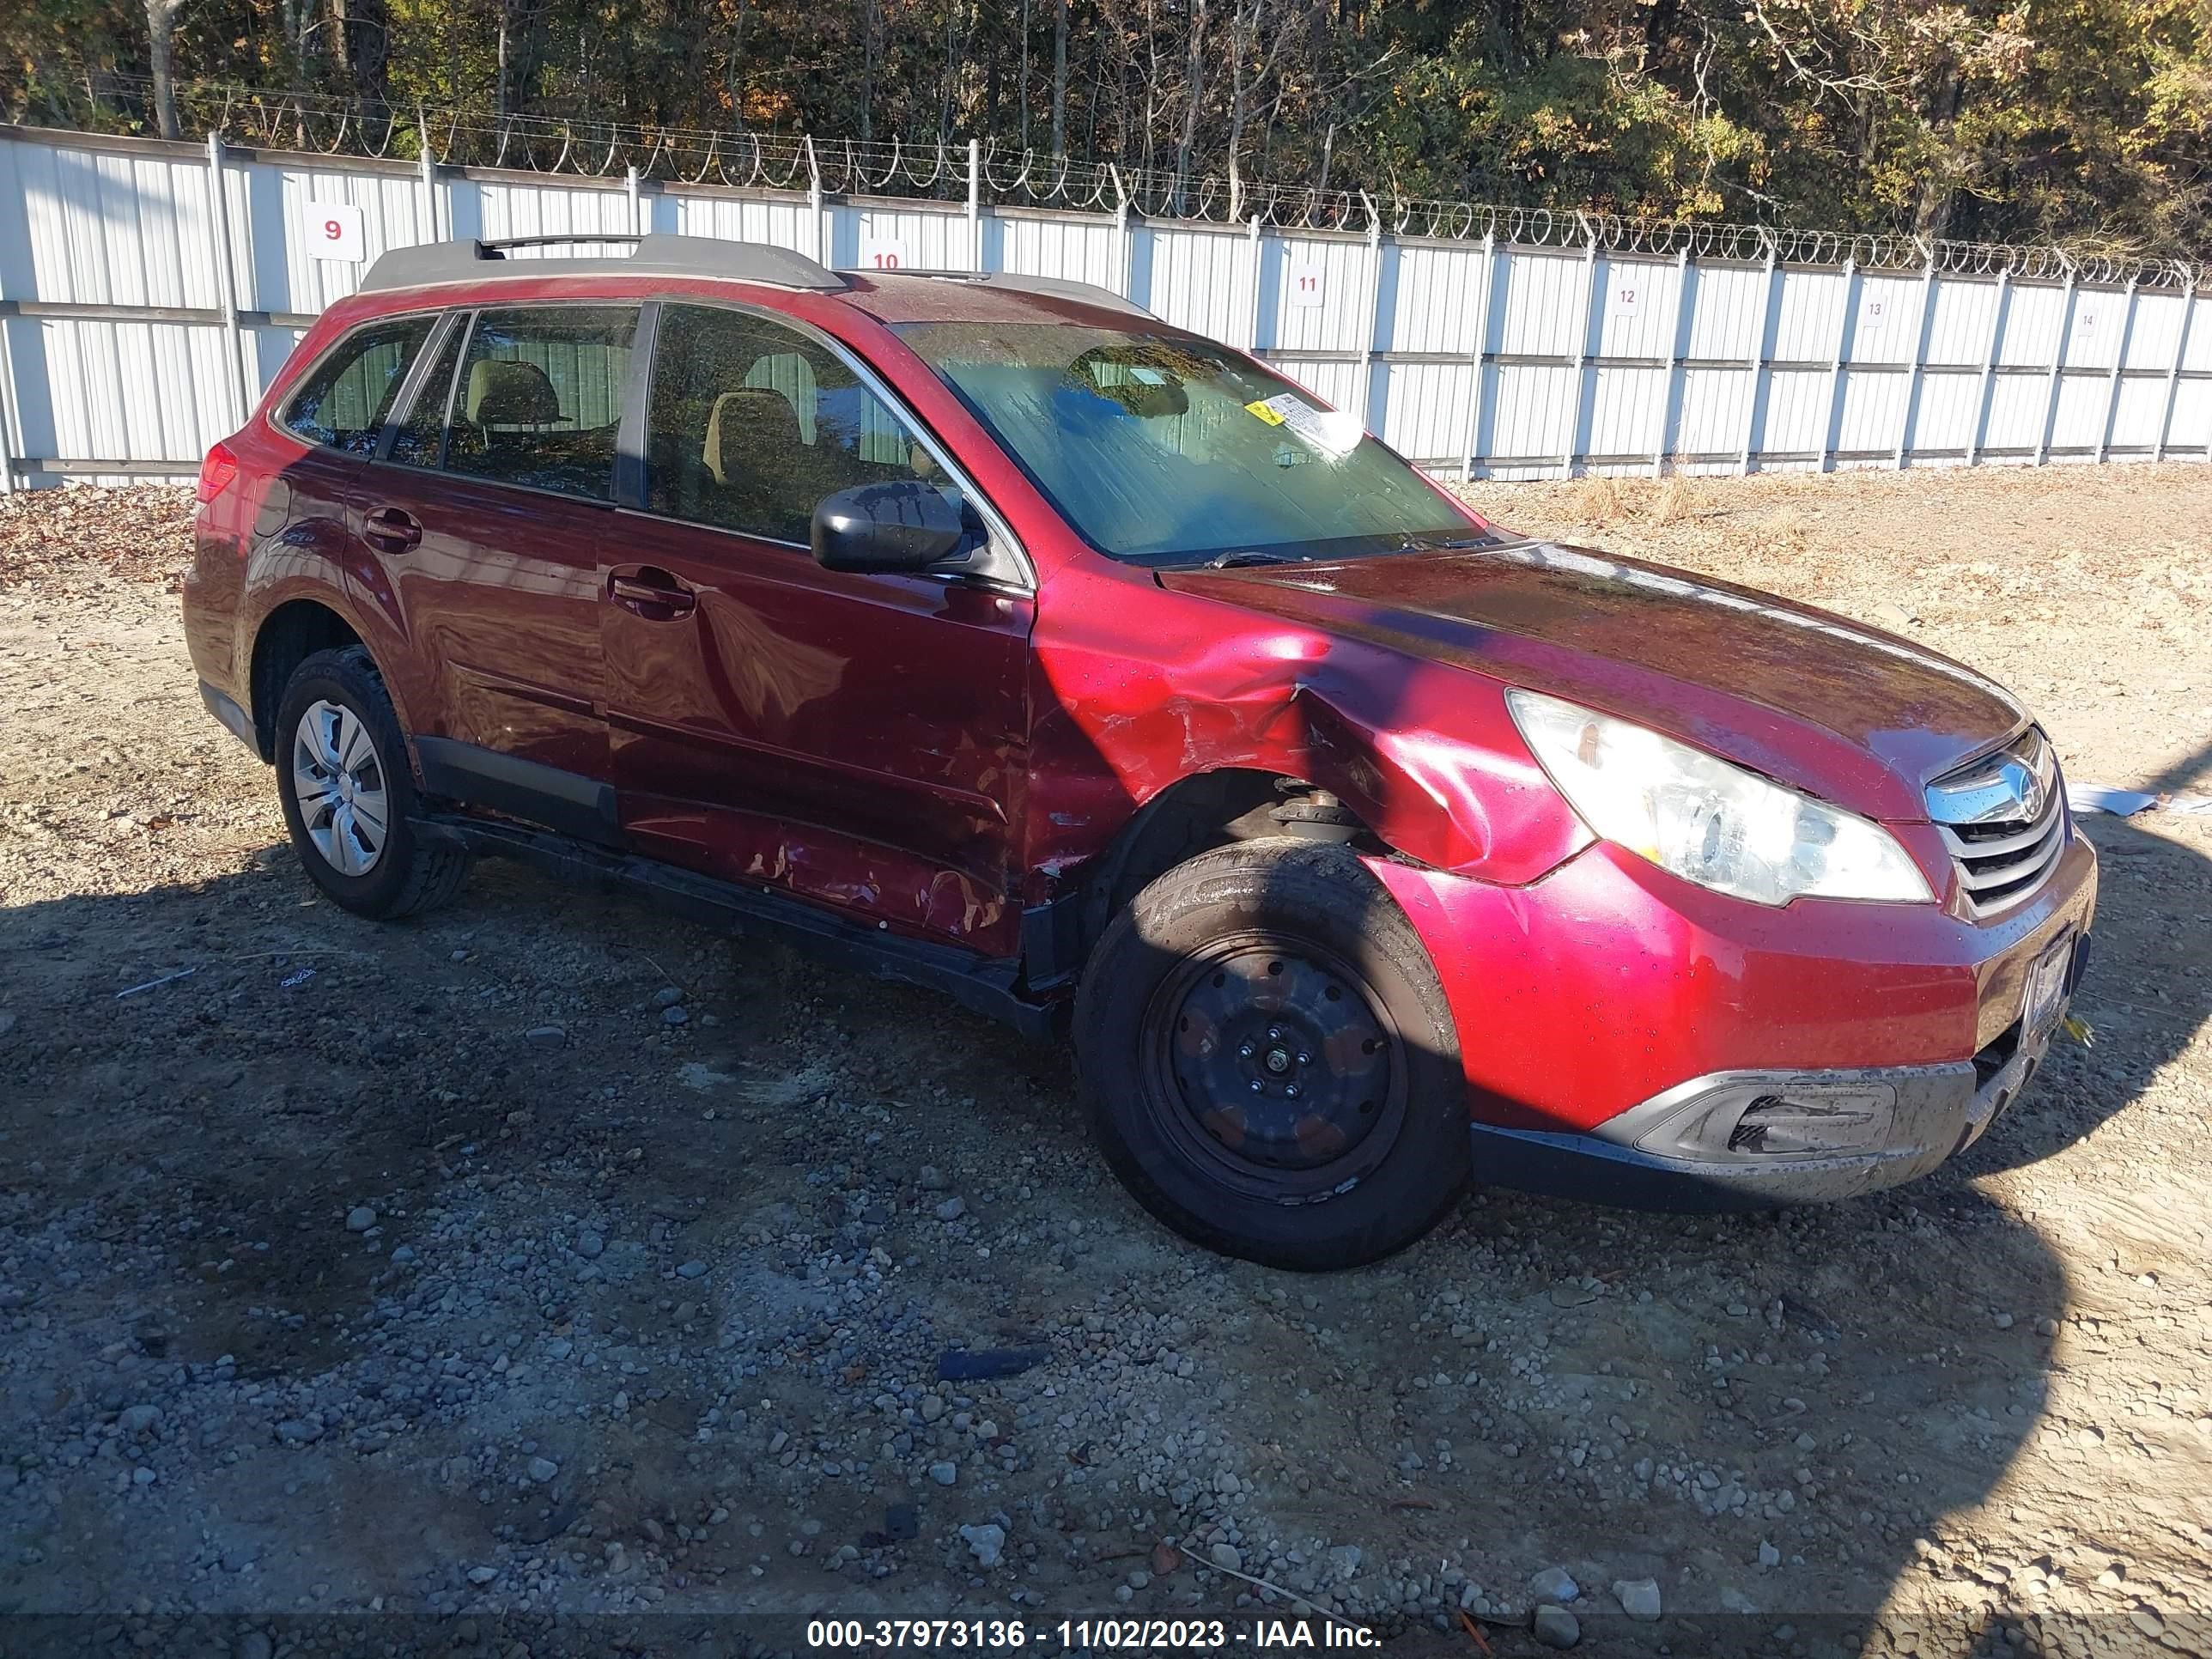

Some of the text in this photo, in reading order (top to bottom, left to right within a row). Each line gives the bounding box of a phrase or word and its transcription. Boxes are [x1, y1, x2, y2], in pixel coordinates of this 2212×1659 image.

[325, 220, 343, 240] 9
[874, 253, 898, 270] 10
[1299, 277, 1316, 292] 11
[1620, 290, 1635, 303] 12
[1869, 303, 1881, 315] 13
[2082, 315, 2094, 325] 14
